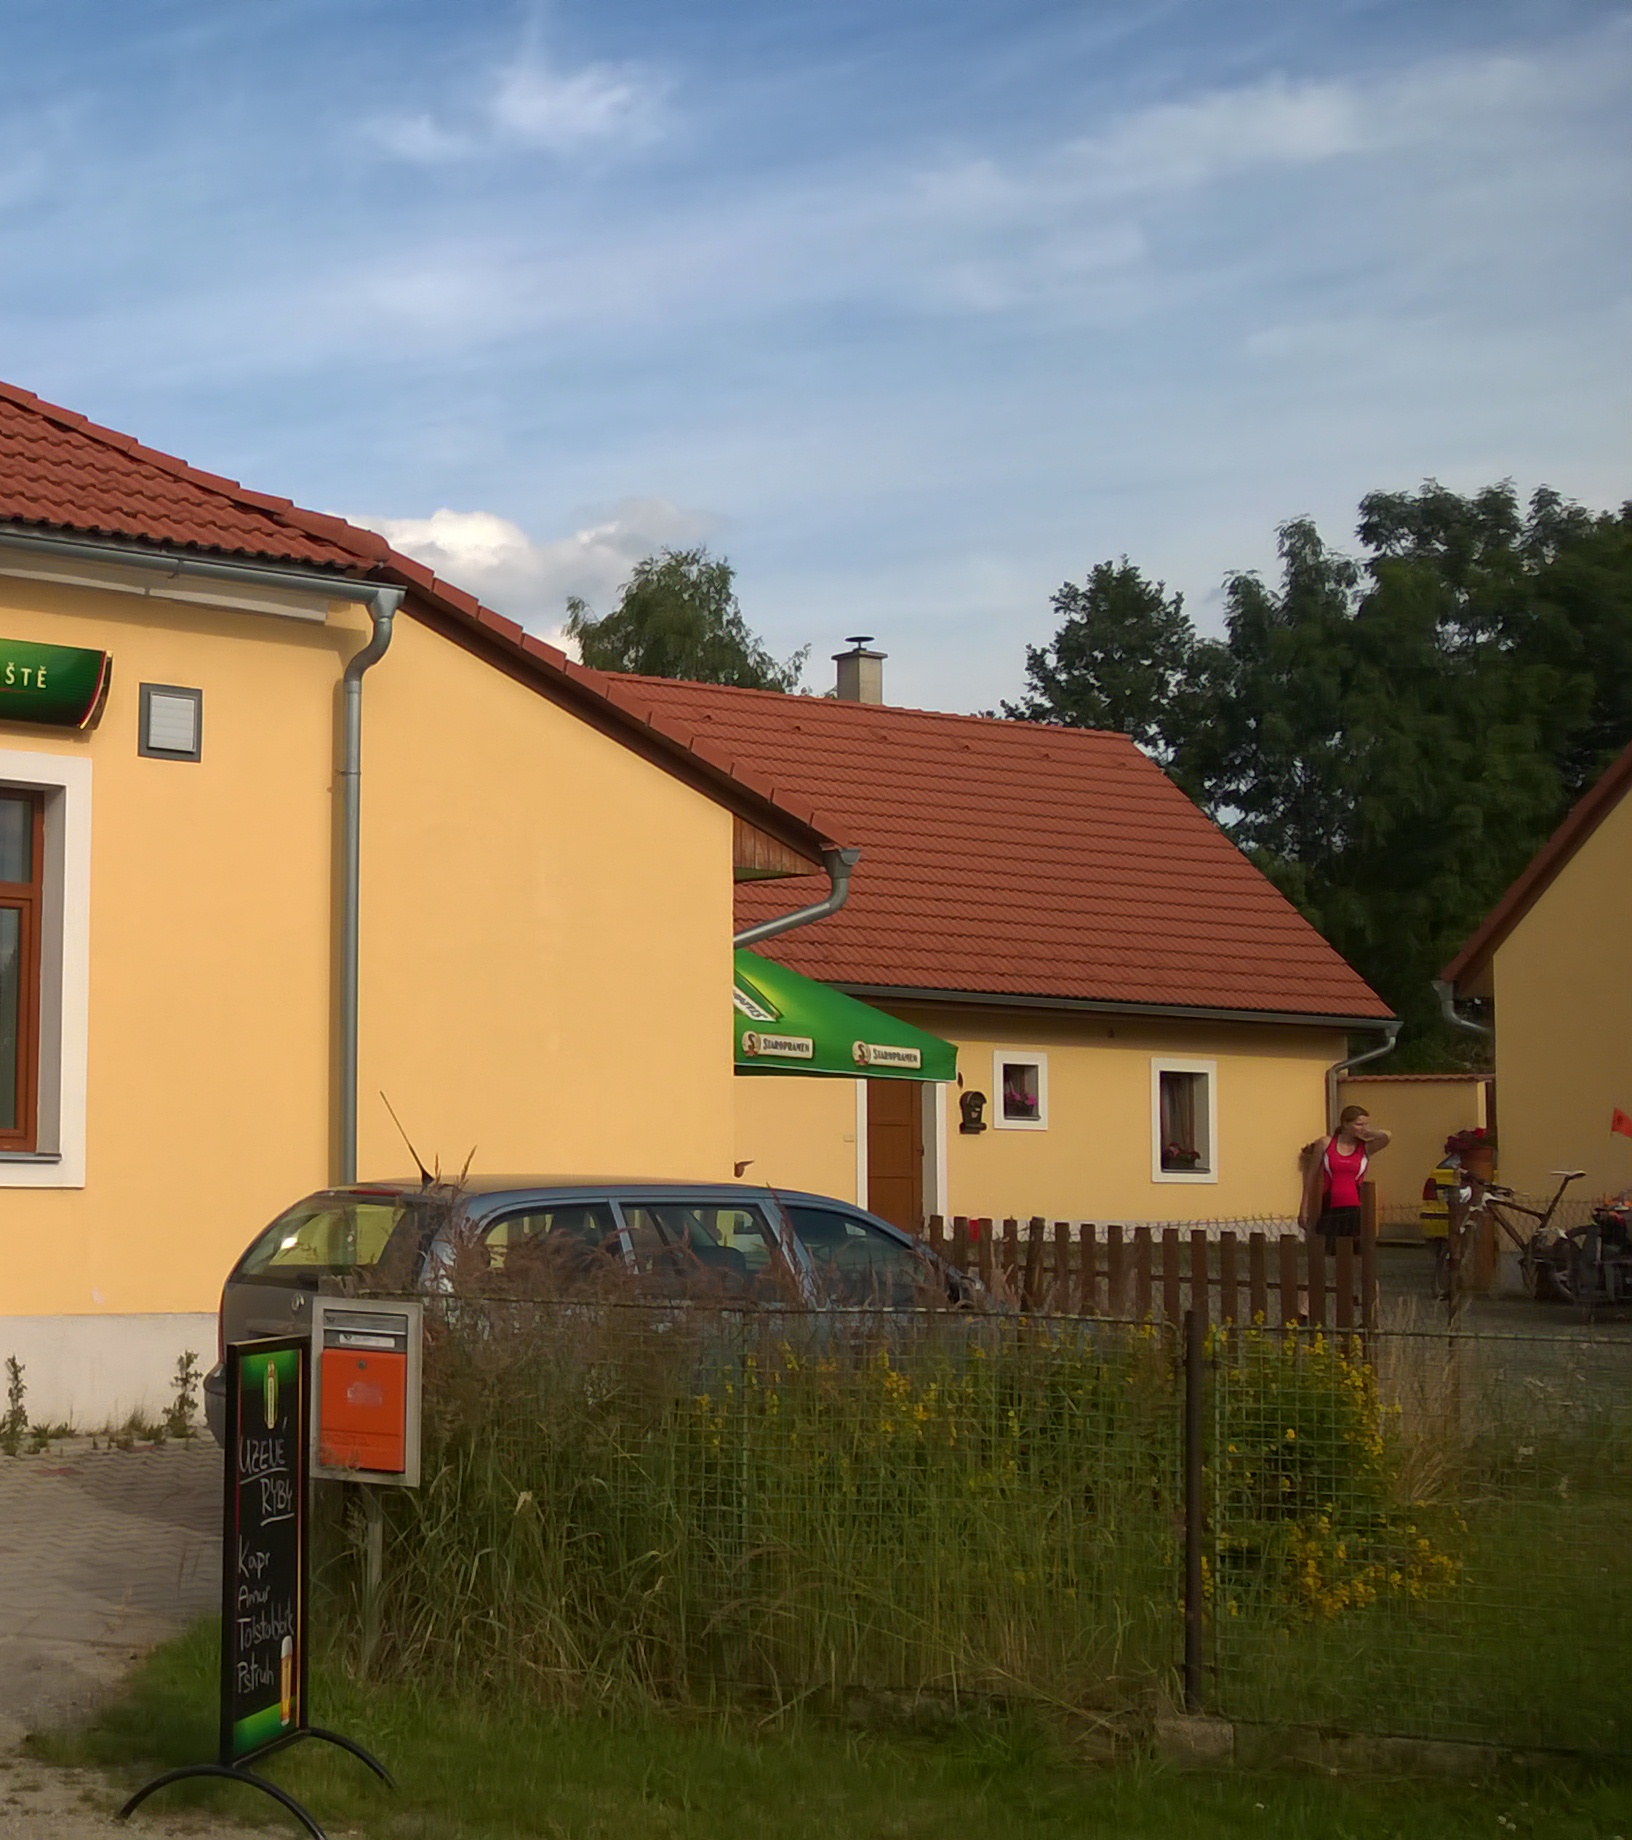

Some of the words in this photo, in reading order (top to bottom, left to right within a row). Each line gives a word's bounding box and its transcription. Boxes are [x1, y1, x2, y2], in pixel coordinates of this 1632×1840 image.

[762, 1037, 810, 1053] STAROPRAMEN
[260, 1478, 294, 1516] RYBY
[237, 1534, 271, 1579] Kapr
[237, 1652, 275, 1694] Pstruh
